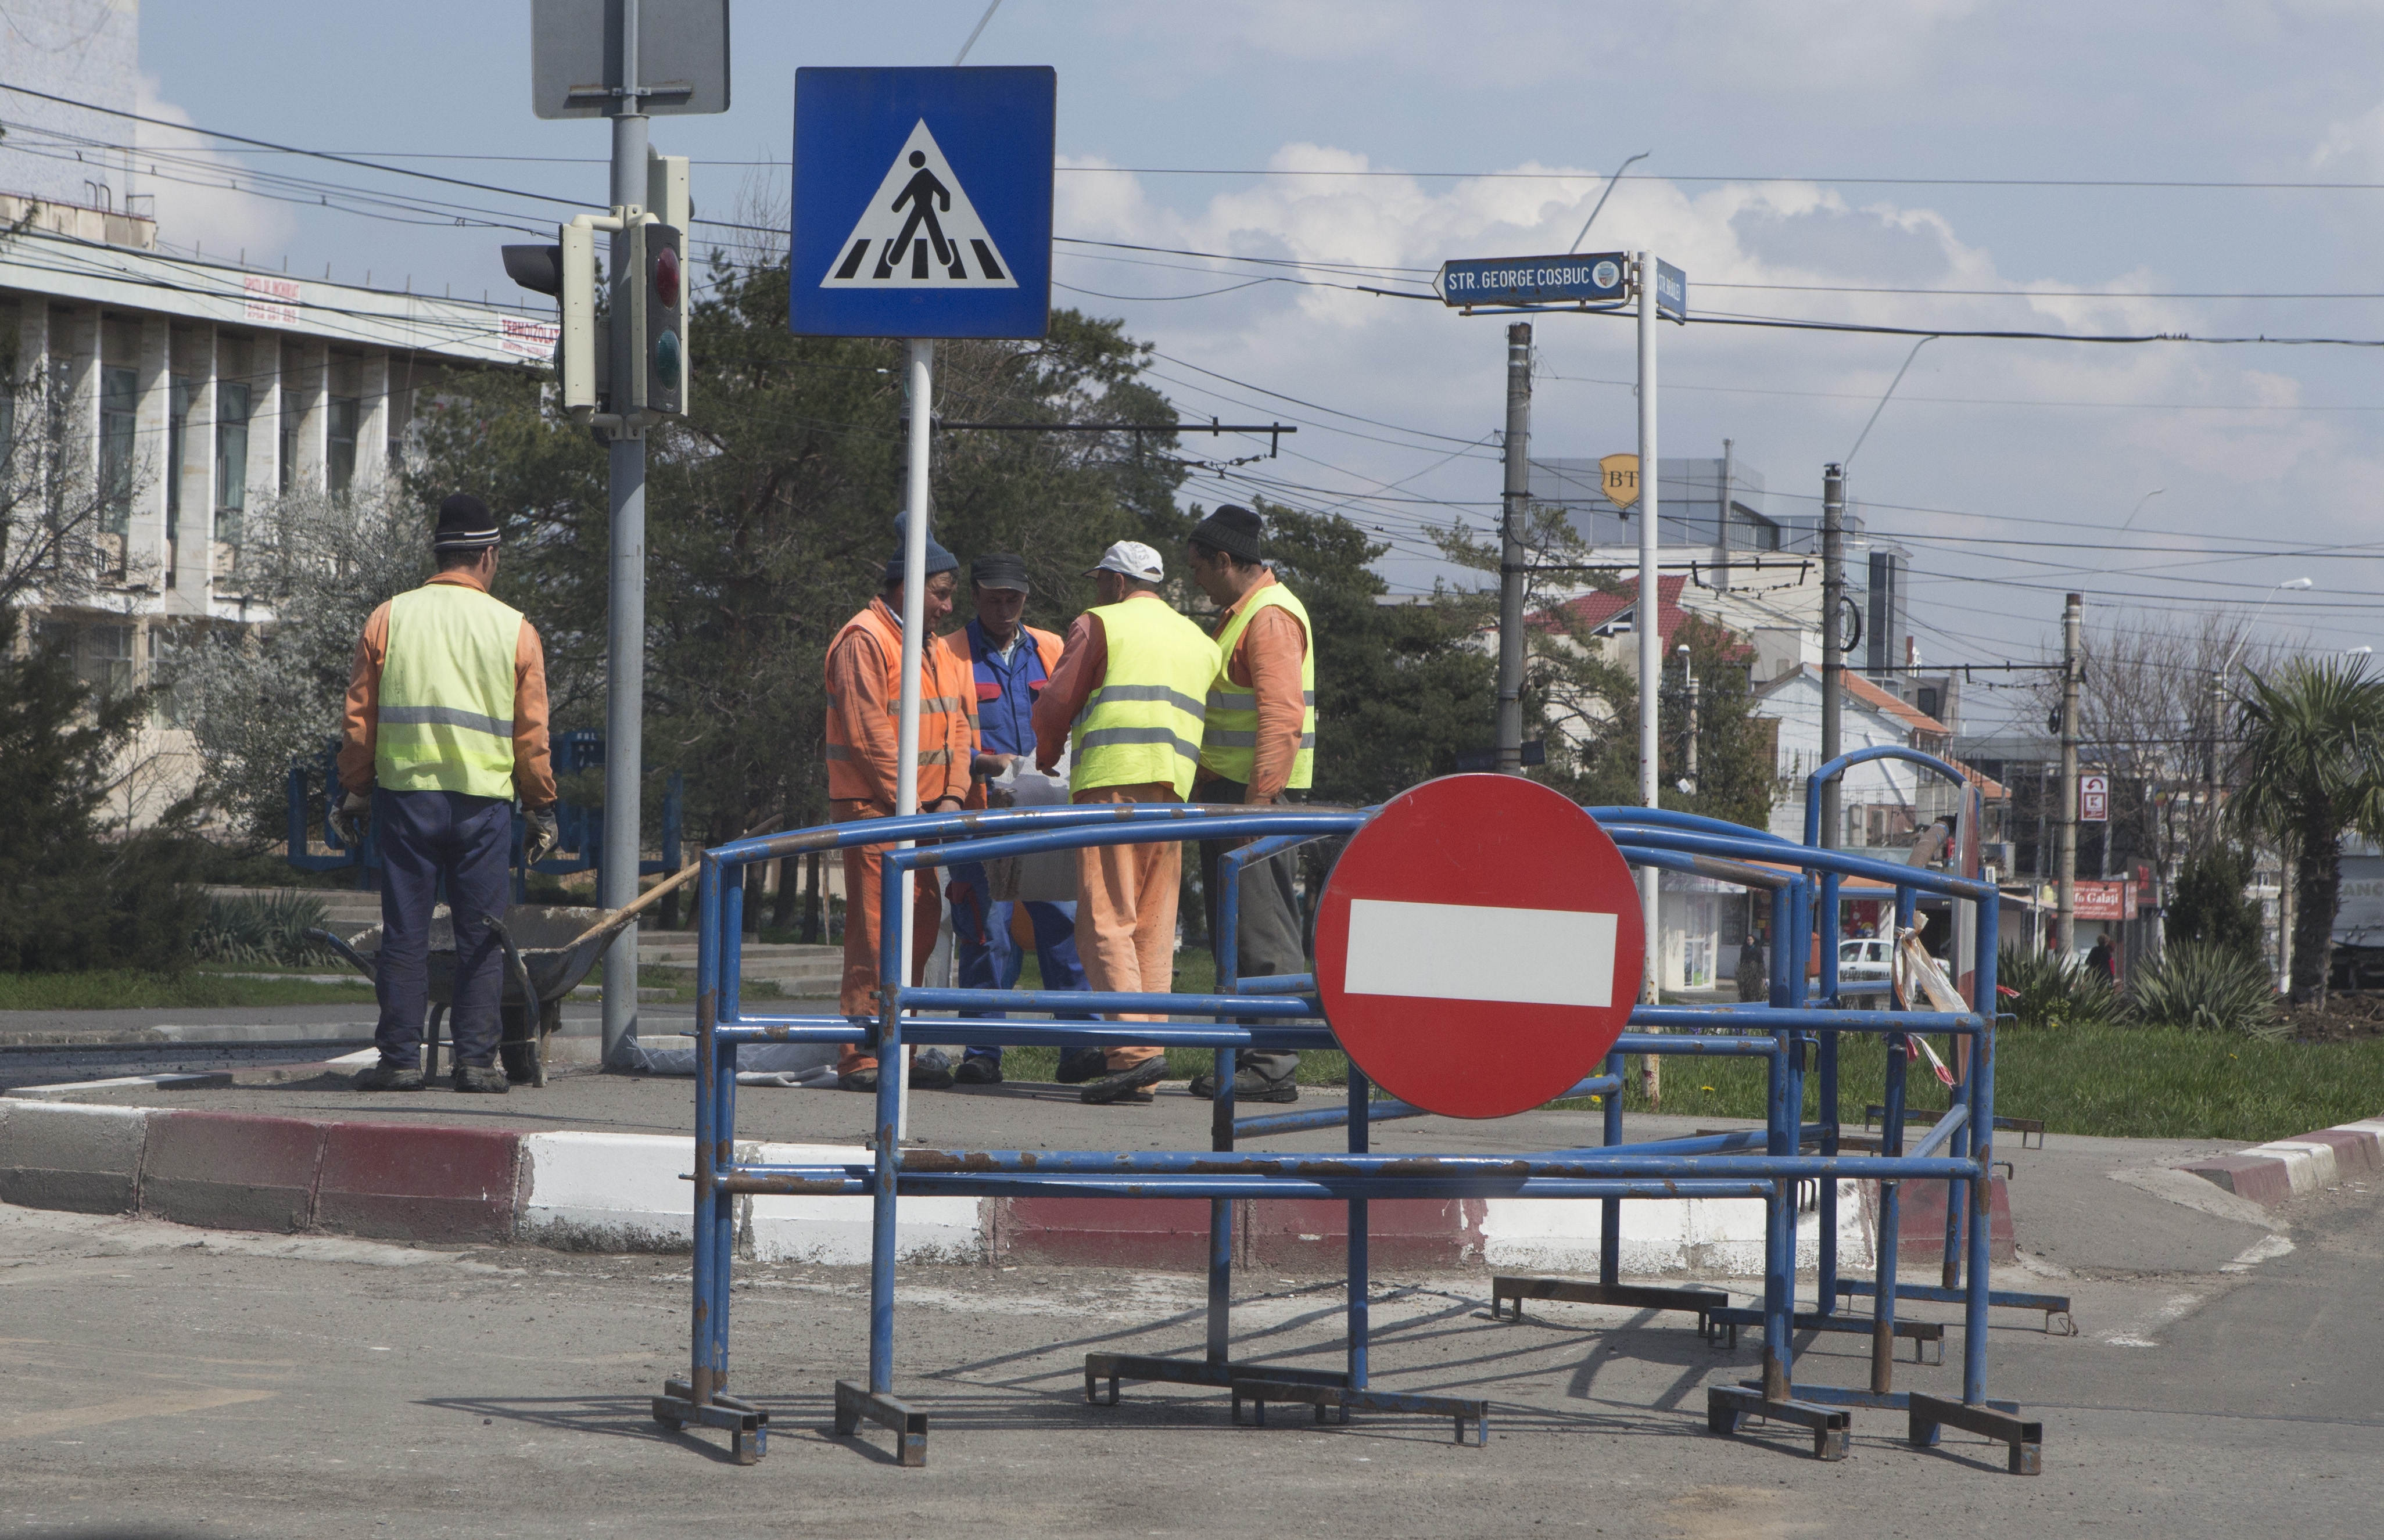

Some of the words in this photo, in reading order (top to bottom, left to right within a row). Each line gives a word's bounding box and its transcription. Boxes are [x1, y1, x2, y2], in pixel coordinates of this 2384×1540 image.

[1449, 272, 1480, 290] STR.
[1482, 269, 1535, 288] GEORGE
[501, 319, 560, 345] TERMOIZOLAT
[1609, 471, 1639, 487] BT
[2074, 892, 2085, 903] fo
